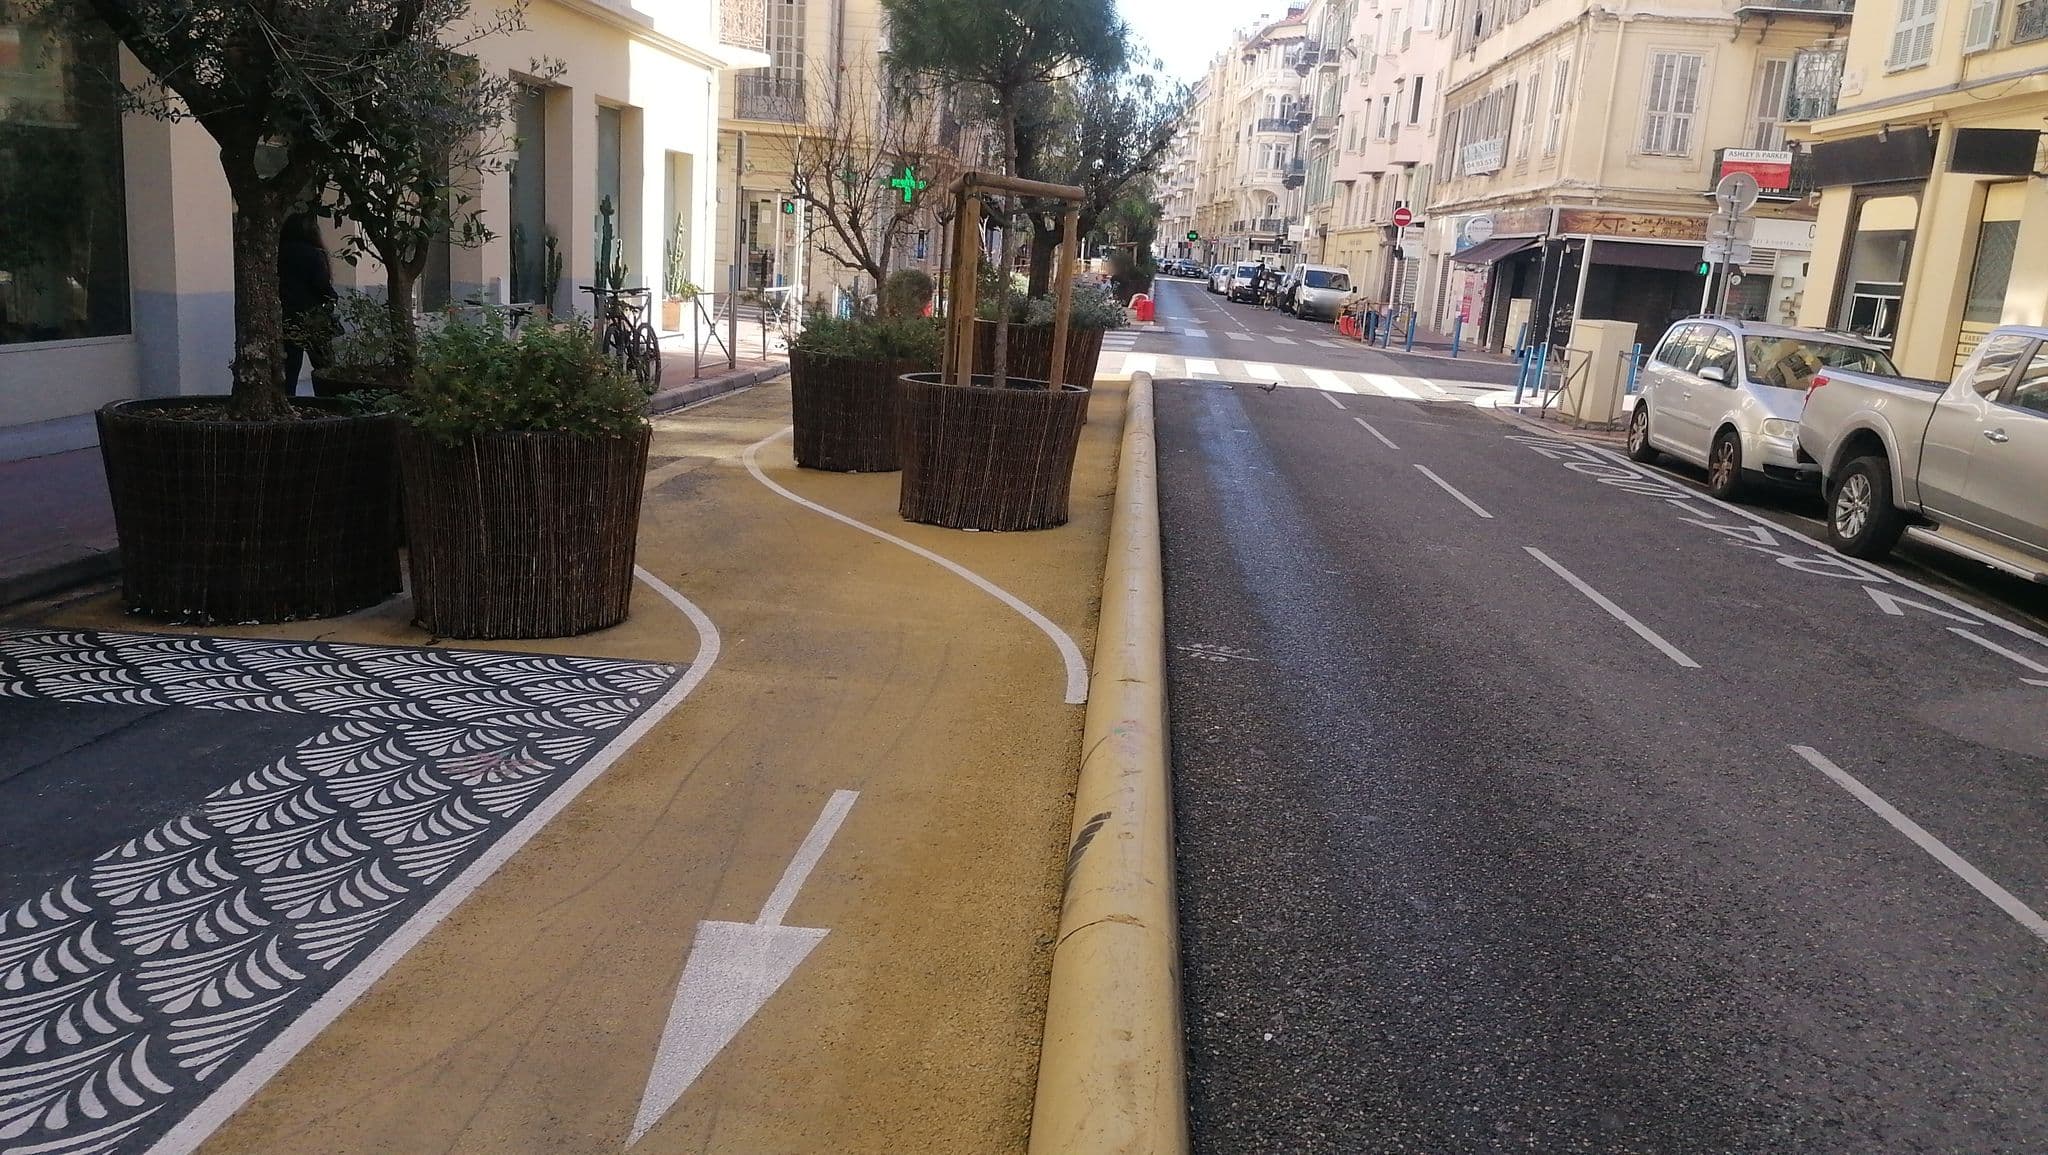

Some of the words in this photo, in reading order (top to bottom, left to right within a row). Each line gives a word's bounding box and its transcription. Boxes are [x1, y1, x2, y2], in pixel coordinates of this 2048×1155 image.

[1728, 150, 1755, 158] ASHLEY
[1762, 152, 1788, 160] PARKER
[1505, 435, 2048, 688] IVRAISONS
